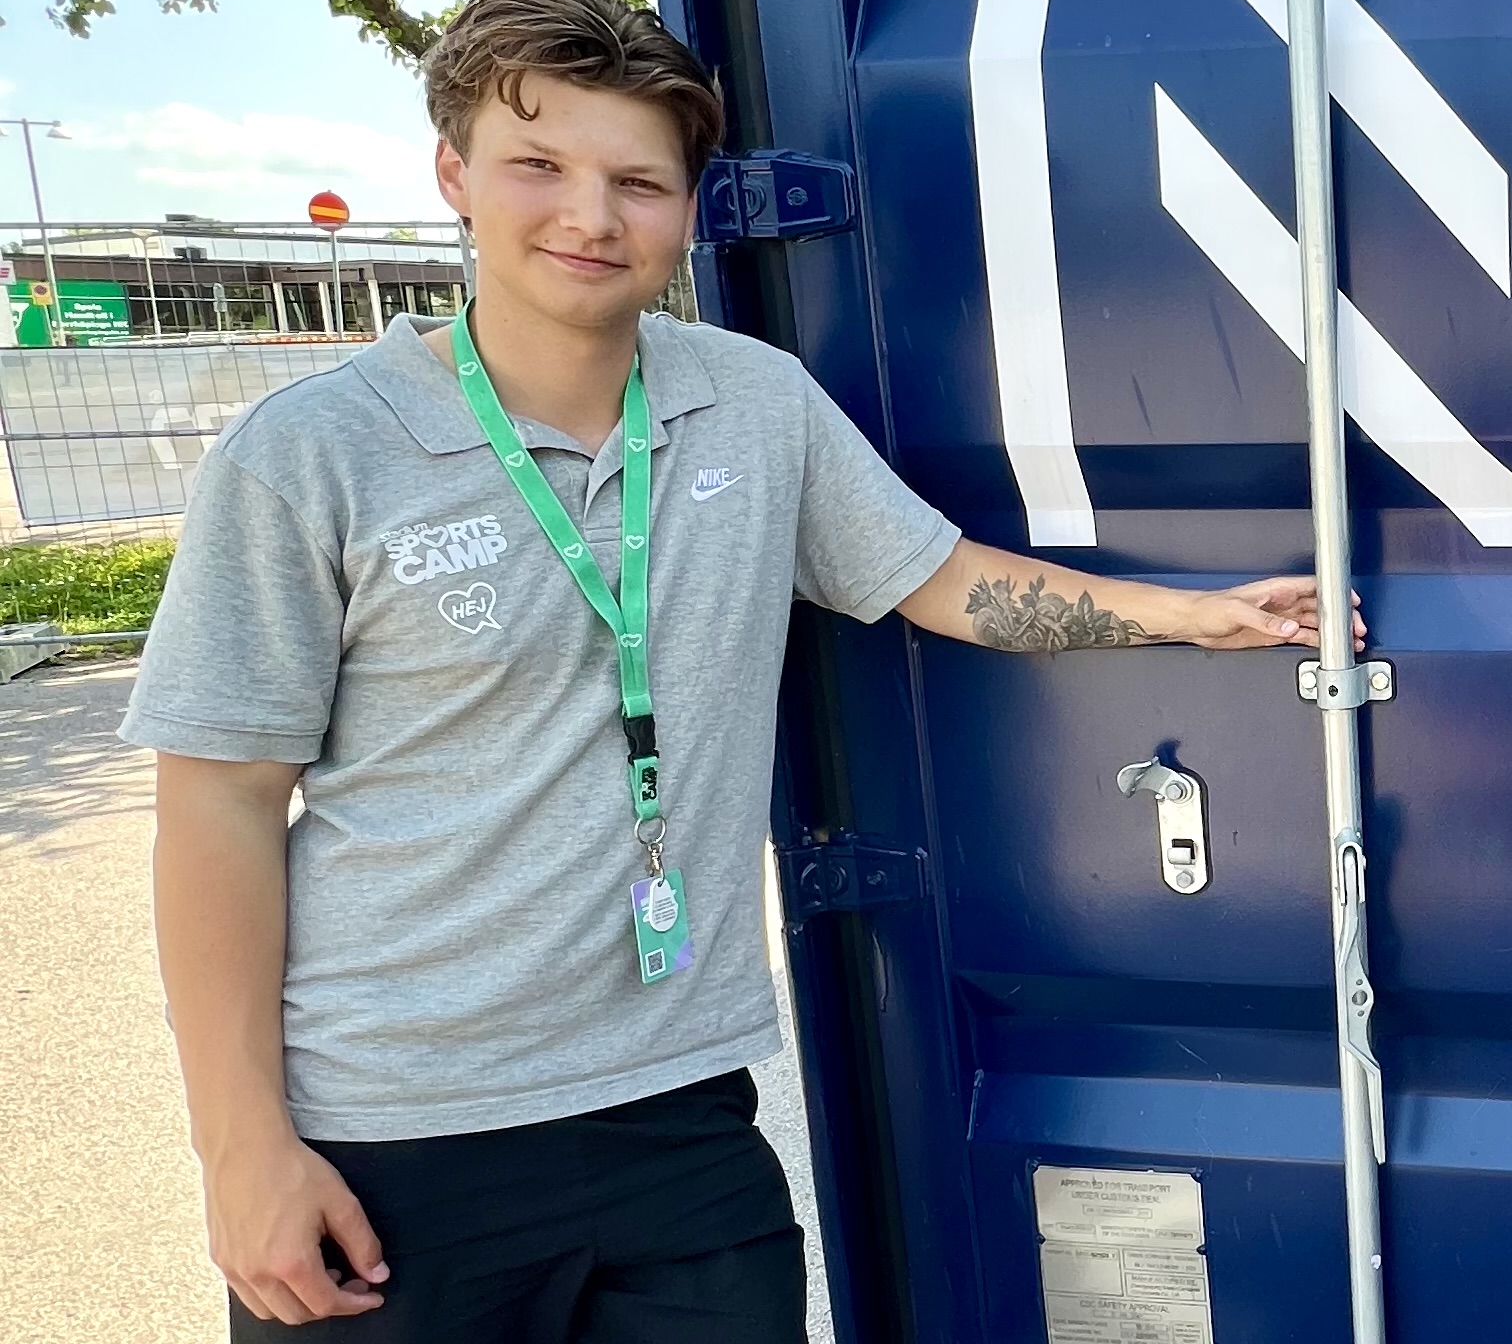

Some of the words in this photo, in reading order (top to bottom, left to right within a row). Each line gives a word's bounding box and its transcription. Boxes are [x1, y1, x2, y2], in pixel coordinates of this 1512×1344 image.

[697, 467, 730, 487] NIKE
[393, 534, 508, 586] CAMP
[451, 596, 487, 621] HEJ
